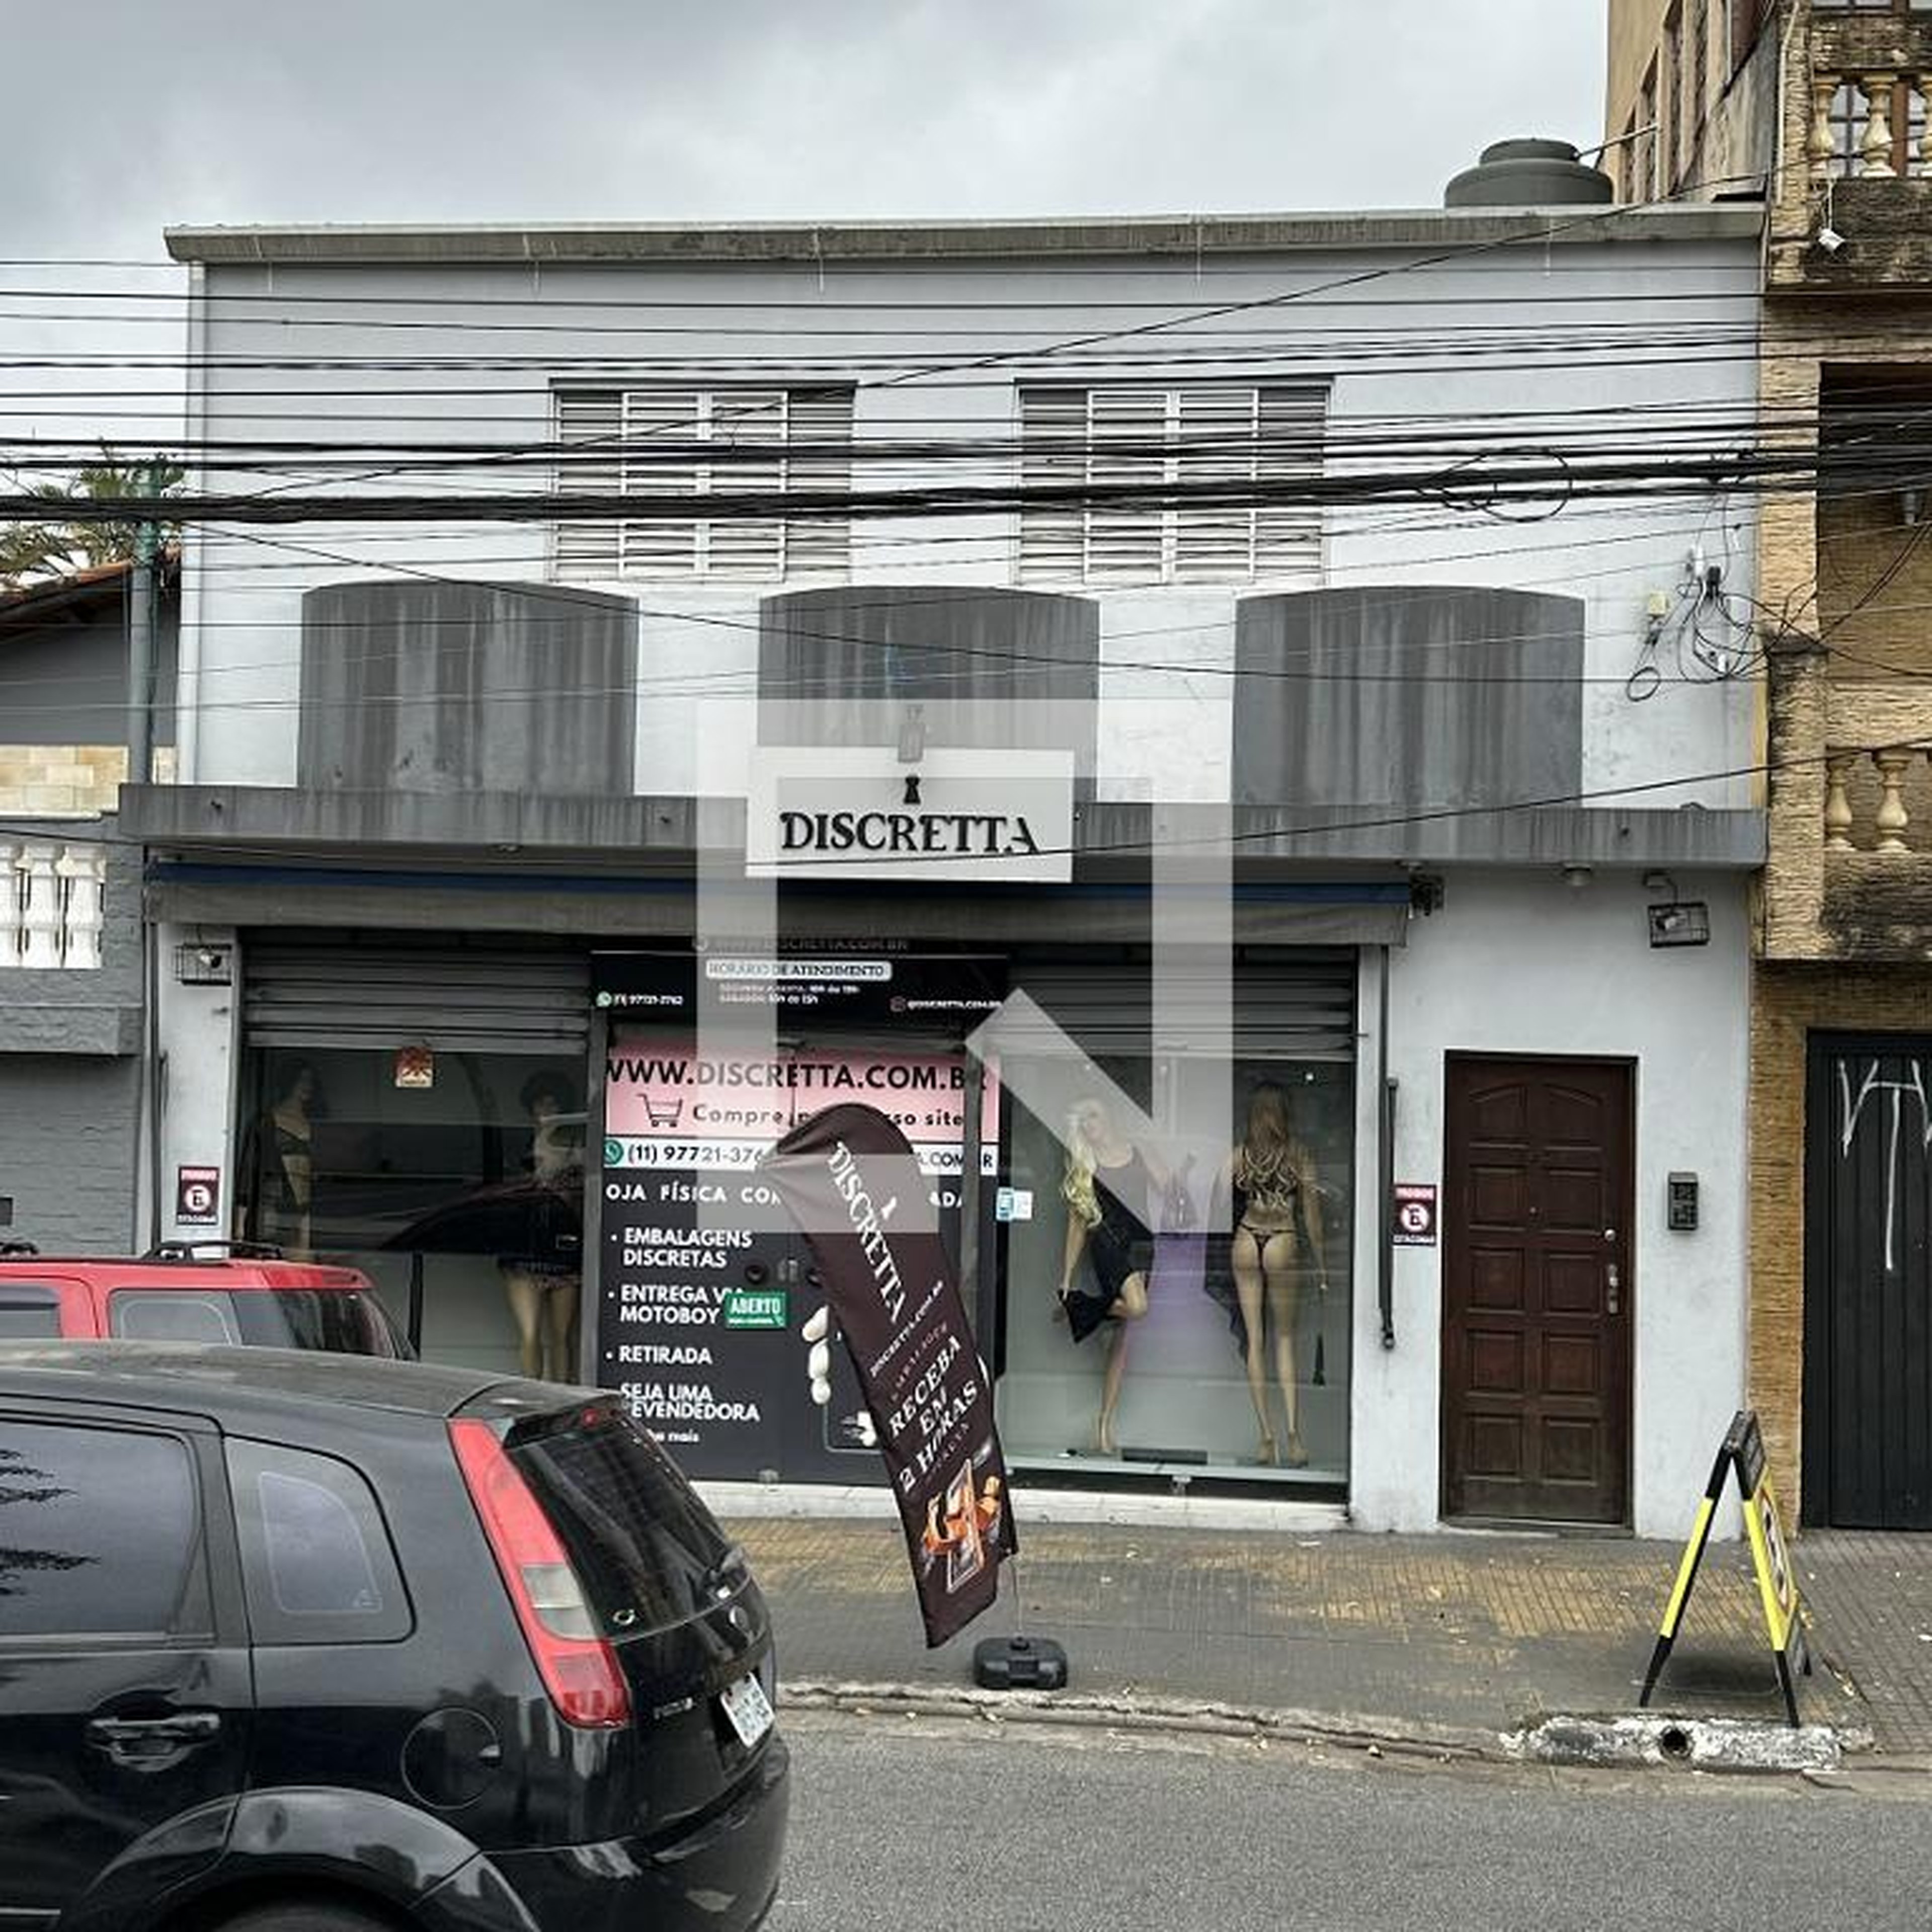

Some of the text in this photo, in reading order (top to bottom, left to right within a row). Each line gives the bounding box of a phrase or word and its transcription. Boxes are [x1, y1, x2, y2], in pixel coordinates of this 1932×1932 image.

[779, 811, 1037, 854] DISCRETTA
[792, 964, 883, 976] ATENDIMENTO
[693, 1103, 783, 1126] Compre
[925, 1108, 963, 1125] site
[628, 1144, 763, 1164] (11) 97721-376
[606, 1184, 647, 1201] OJA
[661, 1181, 727, 1202] FÍSICA
[624, 1228, 753, 1248] EMBALAGENS
[828, 1141, 906, 1323] DISCRETTA
[623, 1249, 727, 1268] DISCRETAS
[620, 1284, 708, 1303] ENTREGA
[620, 1306, 720, 1324] MOTOBOY
[731, 1298, 781, 1314] ABERTO
[619, 1345, 713, 1364] RETIRADA
[621, 1383, 713, 1402] SEJA UMA
[889, 1335, 961, 1437] RECEBA
[916, 1380, 978, 1473] HORAS
